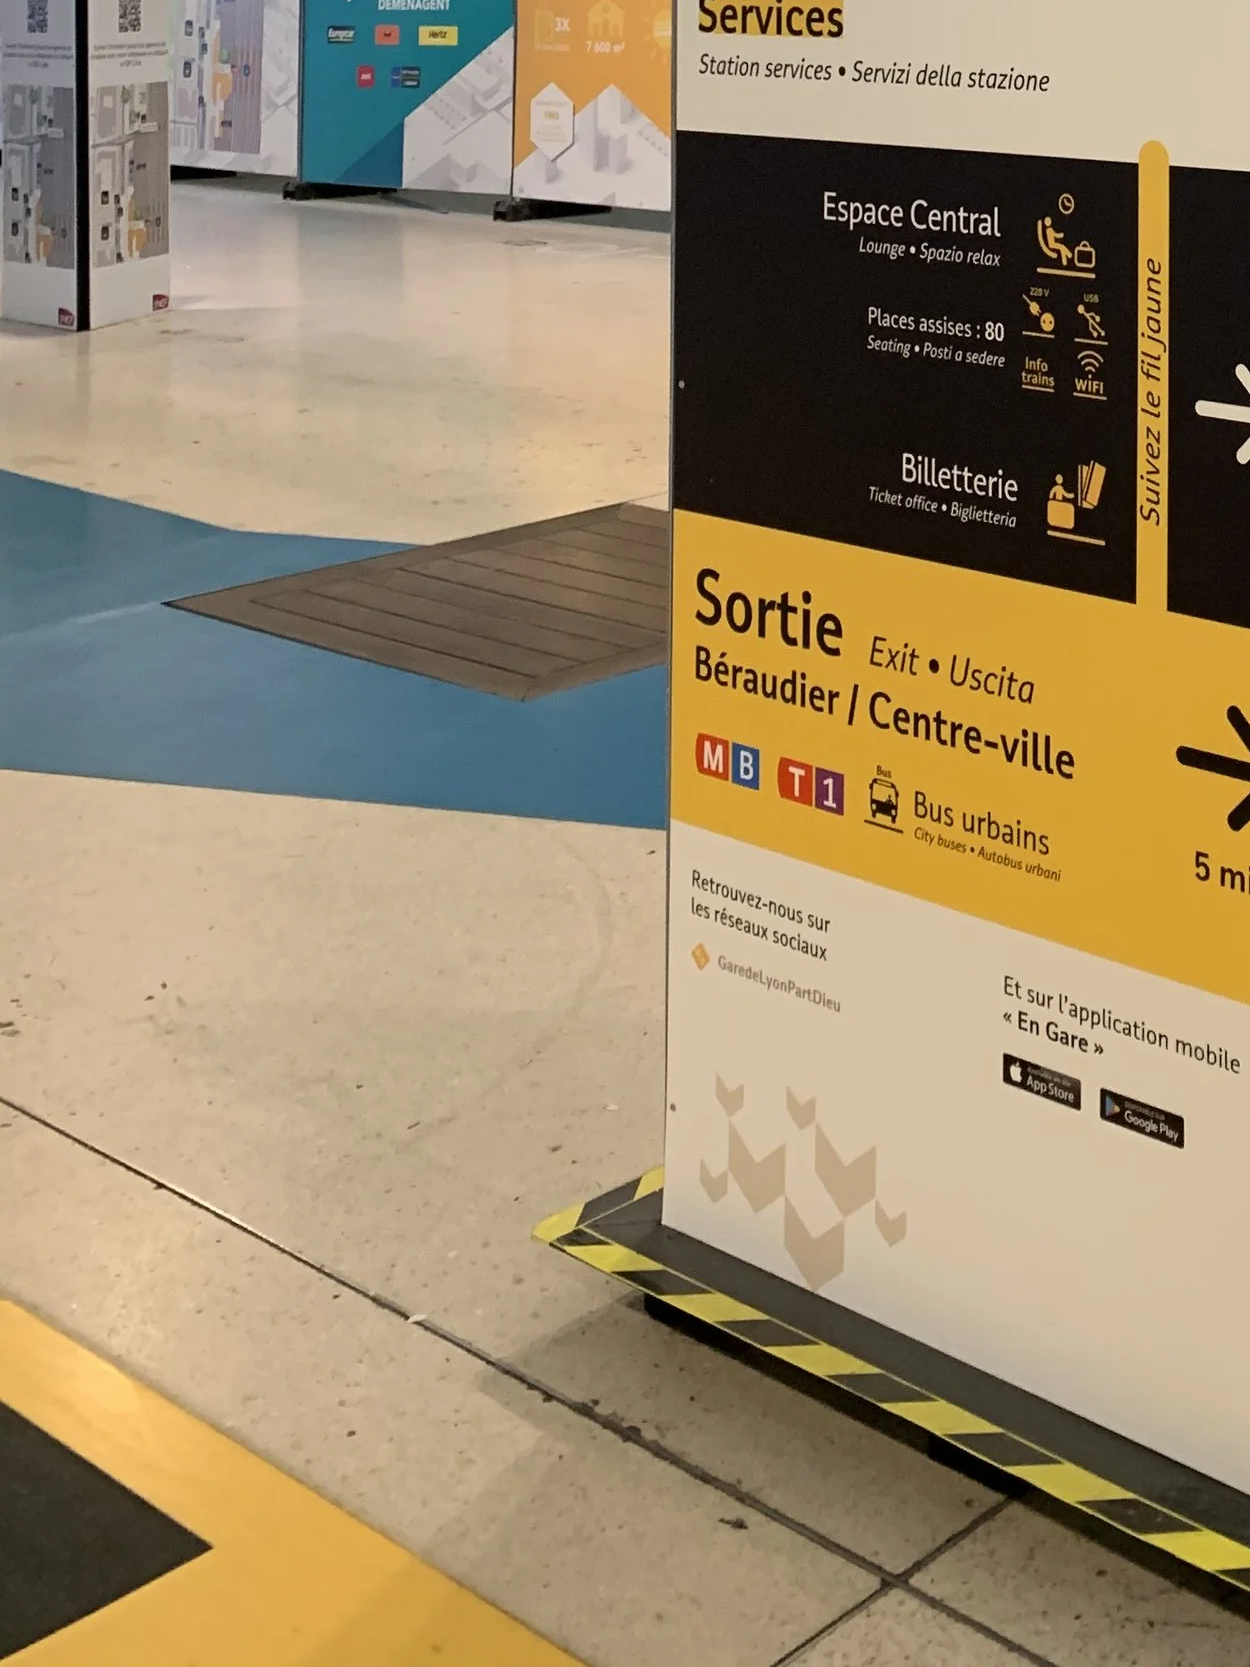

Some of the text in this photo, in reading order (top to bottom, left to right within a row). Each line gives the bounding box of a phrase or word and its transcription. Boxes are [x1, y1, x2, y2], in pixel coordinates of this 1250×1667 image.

[428, 30, 447, 39] Hertz
[698, 53, 1050, 94] Station services Servizi della stazione
[823, 191, 1001, 238] Espace Central
[858, 239, 1001, 268] Lounge Spazio relax
[867, 306, 1005, 342] Places assises 80
[1025, 356, 1048, 371] Info
[1140, 258, 1167, 526] Suivez le fil jaune
[902, 452, 1018, 501] Billetterie
[695, 568, 1035, 704] Sortie Exit Uscita
[695, 645, 1076, 780] Béraudier Centre-ville
[876, 765, 892, 779] Bus
[914, 791, 1051, 855] Bus urbains
[1194, 851, 1210, 882] 5
[692, 870, 830, 934] Retrouvez-nous sur
[691, 897, 827, 961] les réseaux sociaux
[717, 954, 841, 1013] GaredeLyonPartDieu
[1003, 976, 1021, 999] Et
[1026, 988, 1053, 1010] sur
[1175, 1036, 1241, 1074] mobile
[1017, 1011, 1089, 1054] En Gare
[1027, 1075, 1047, 1094] App
[1048, 1083, 1075, 1103] Store
[1124, 1111, 1178, 1141] Google Play
